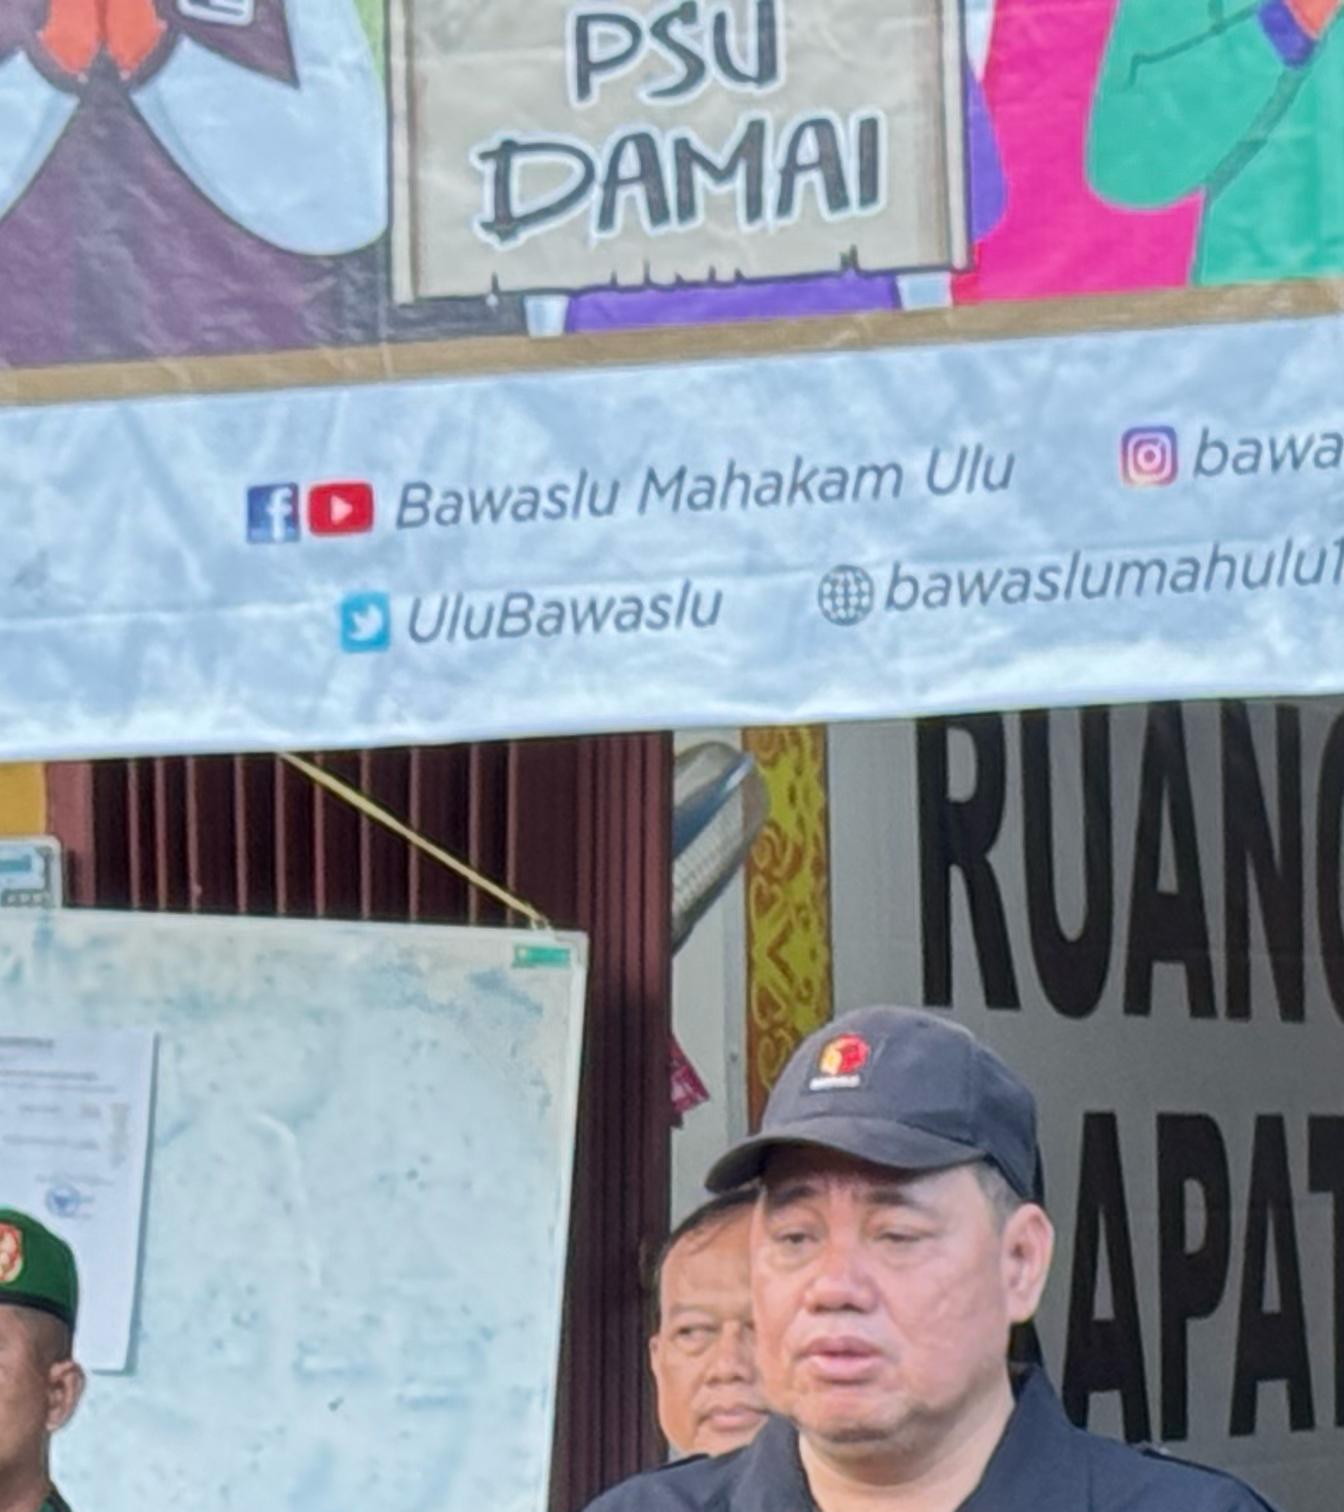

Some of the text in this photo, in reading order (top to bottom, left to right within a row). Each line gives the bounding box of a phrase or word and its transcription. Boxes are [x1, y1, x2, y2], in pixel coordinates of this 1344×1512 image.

[573, 0, 778, 101] PSU
[477, 117, 879, 239] DAMAI
[395, 467, 619, 531] Bawaslu
[637, 453, 902, 517] Mahakam
[926, 443, 1015, 495] Ulu
[408, 580, 723, 644] UluBawaslu
